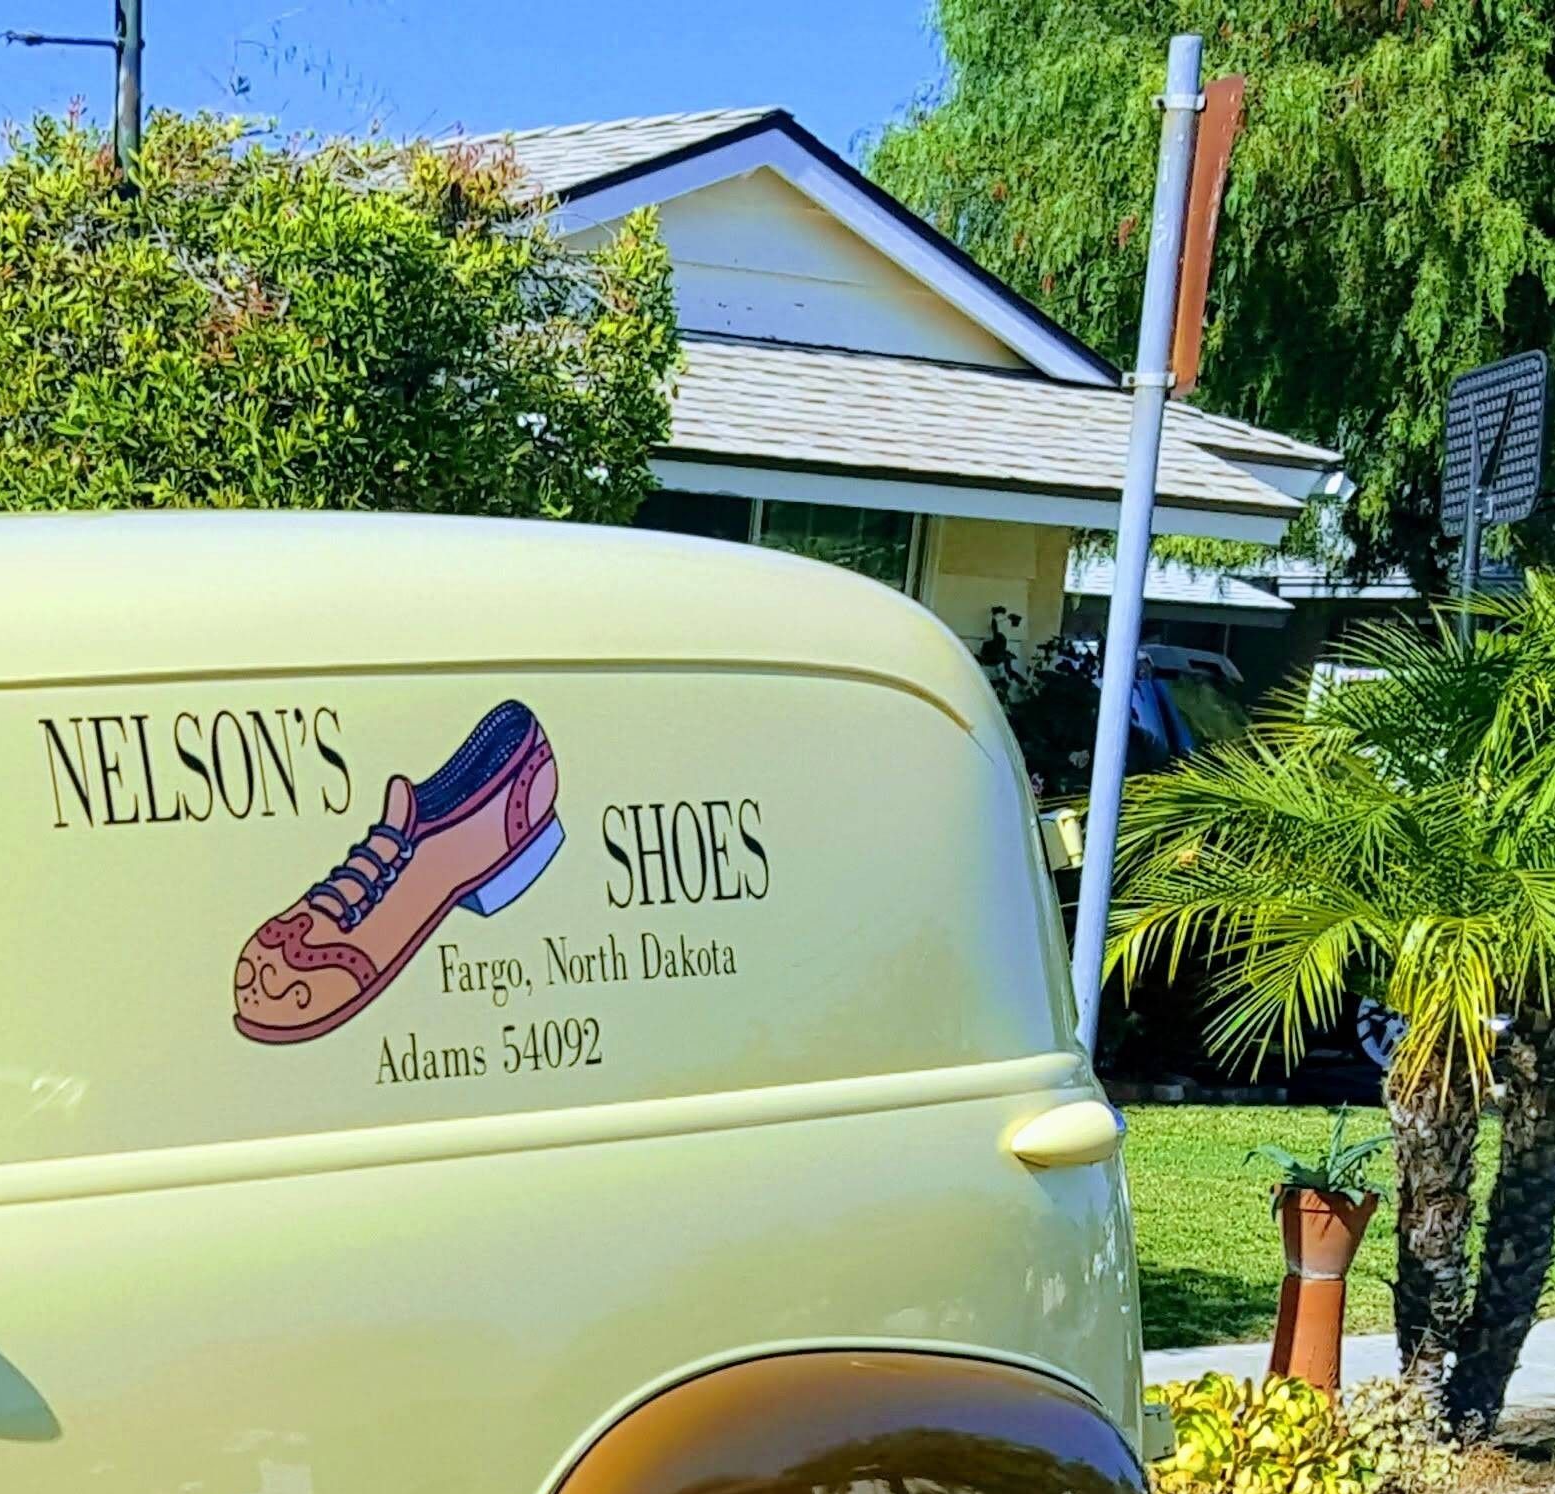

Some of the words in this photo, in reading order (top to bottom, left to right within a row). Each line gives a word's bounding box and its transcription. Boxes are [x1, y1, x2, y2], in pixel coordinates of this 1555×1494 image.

[39, 706, 353, 828] NELSON'S
[601, 798, 770, 911] SHOES
[438, 944, 533, 1007] Fargo,
[543, 935, 630, 987] North
[641, 932, 738, 980] Dakota
[375, 1032, 488, 1086] Adams
[501, 1016, 604, 1074] 54092
